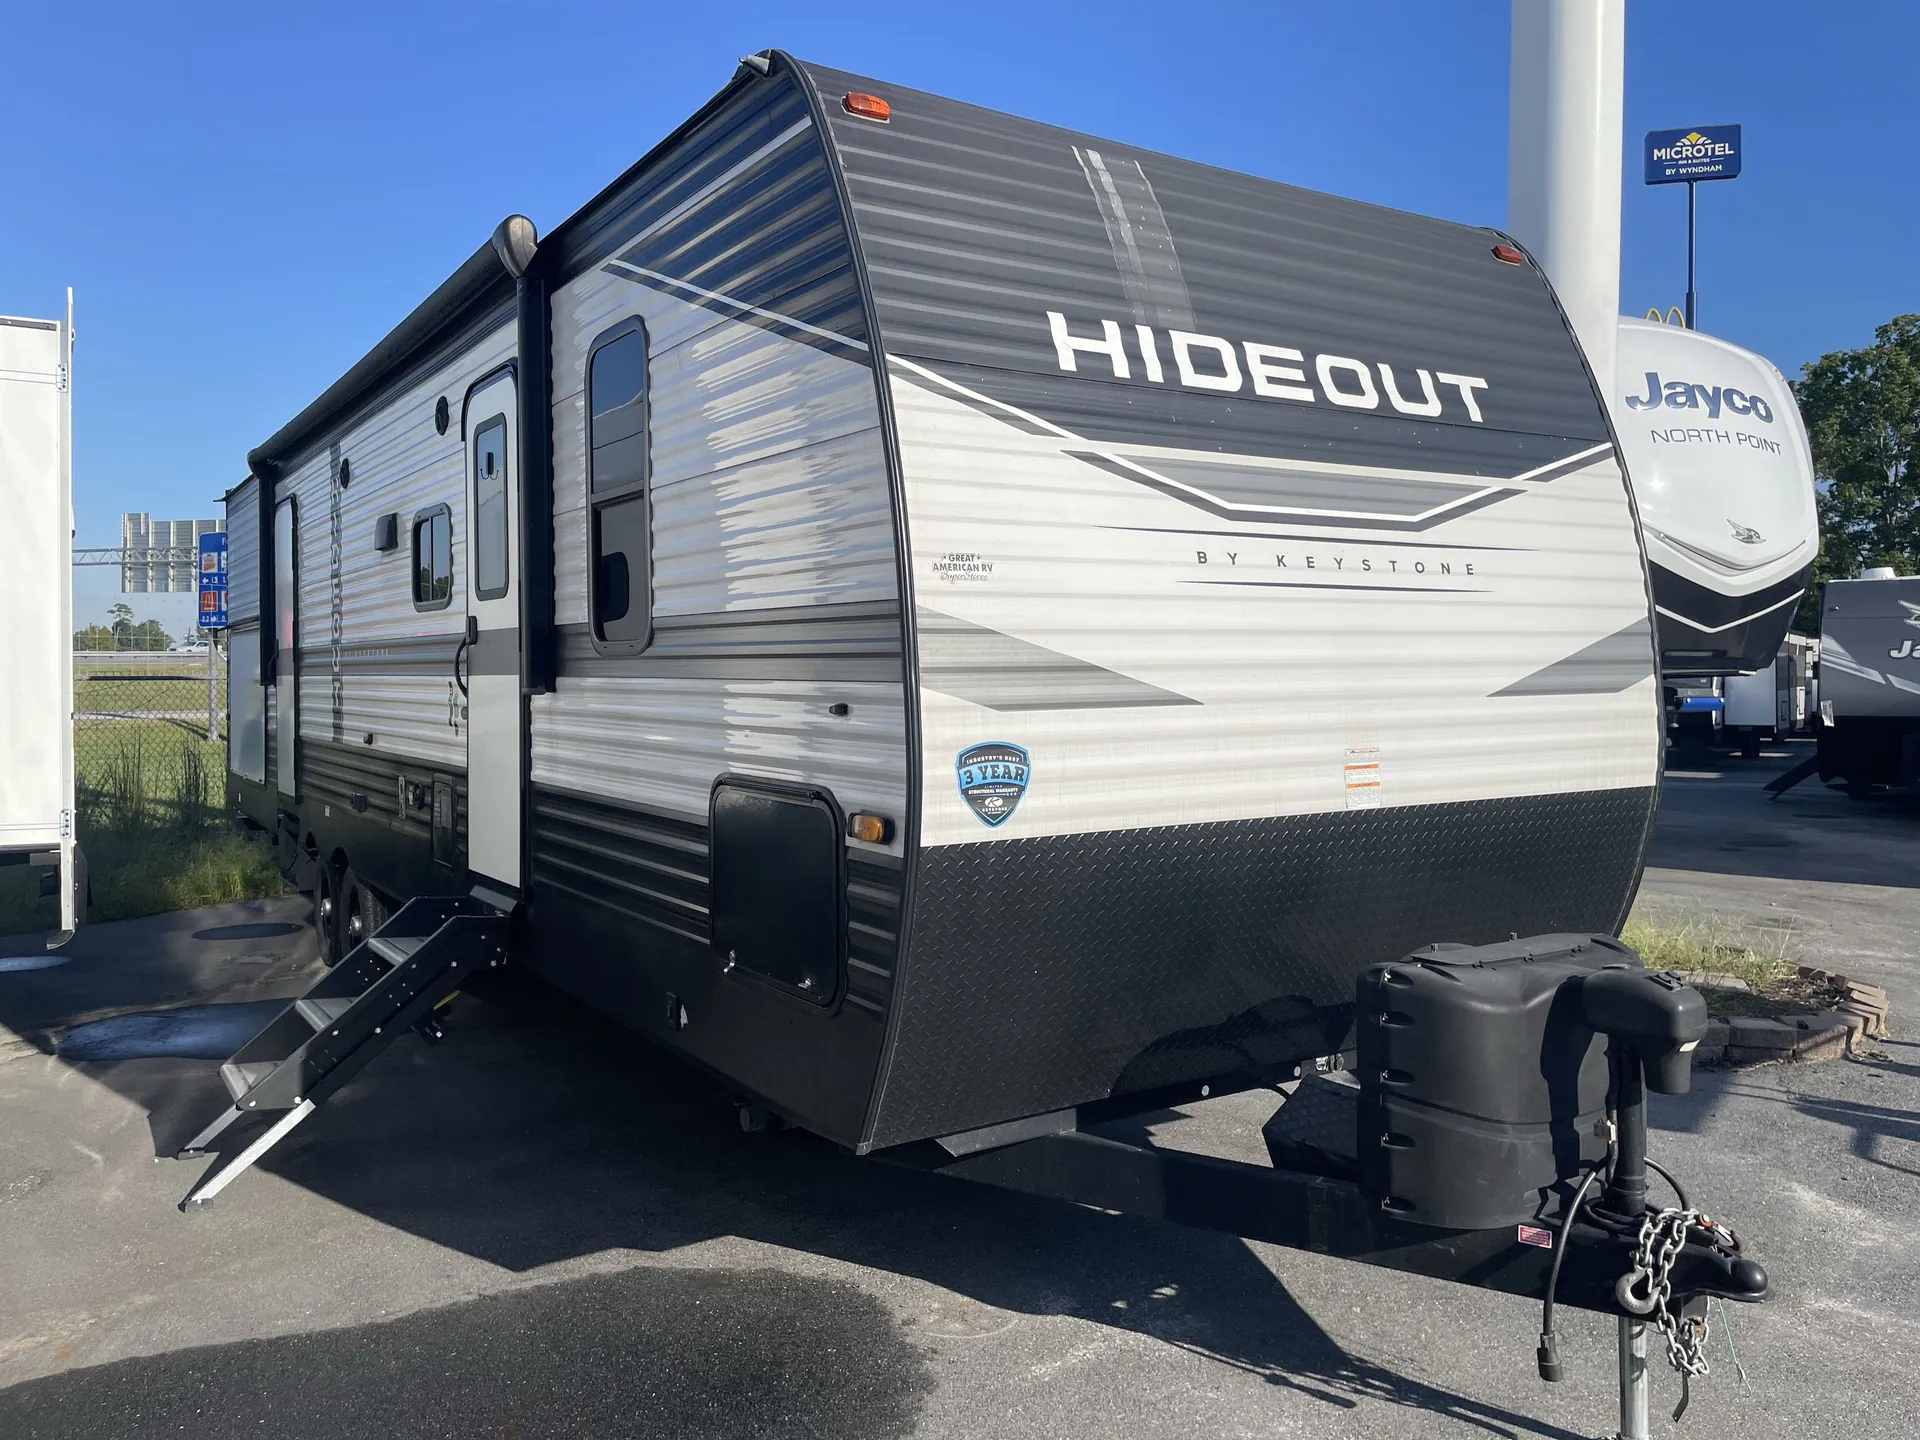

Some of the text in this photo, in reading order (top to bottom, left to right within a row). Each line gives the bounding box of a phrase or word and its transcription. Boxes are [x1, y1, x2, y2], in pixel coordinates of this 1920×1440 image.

[1653, 143, 1734, 160] MICROTEL
[1679, 165, 1722, 174] WYNDHAM
[1046, 311, 1489, 423] HIDEOUT
[1625, 372, 1774, 424] Jayco
[1651, 429, 1782, 456] NORTH POINT
[933, 563, 993, 572] AMERICAN RV
[948, 554, 975, 562] GREAT
[1196, 551, 1475, 577] BY KEYSTONE
[964, 765, 1024, 785] 3 YEAR
